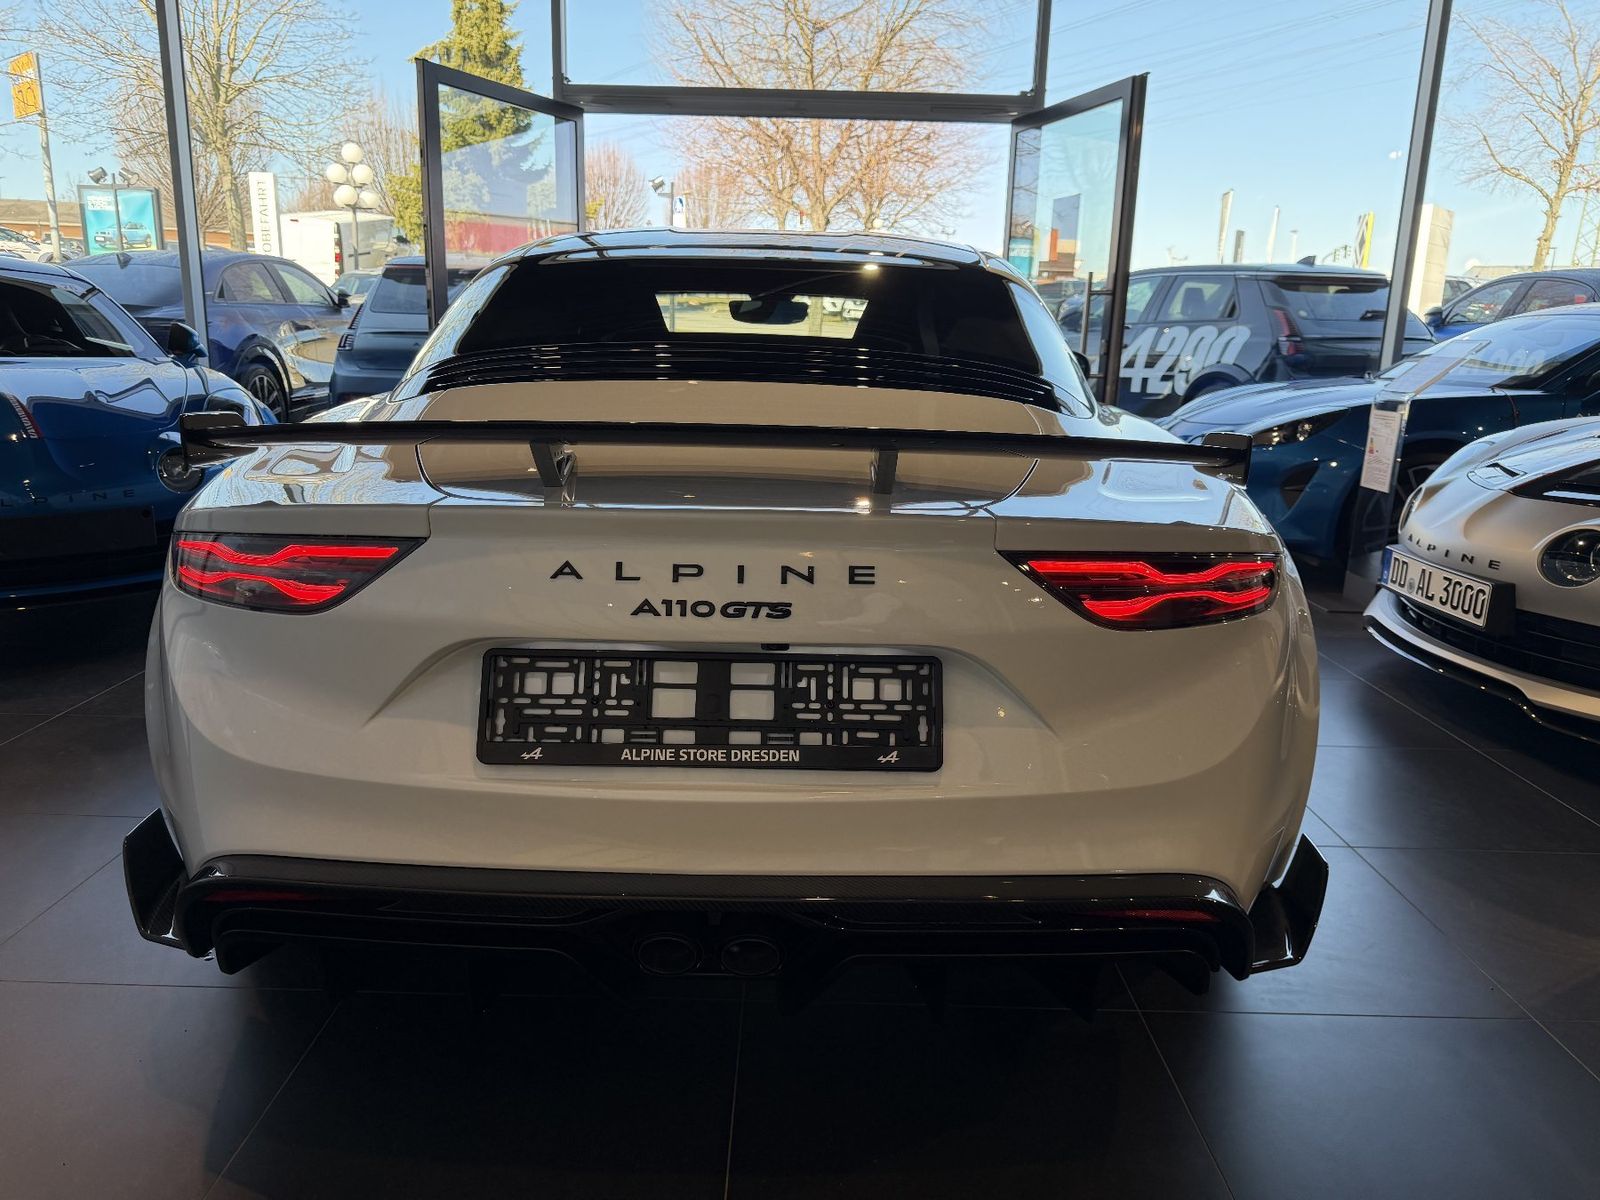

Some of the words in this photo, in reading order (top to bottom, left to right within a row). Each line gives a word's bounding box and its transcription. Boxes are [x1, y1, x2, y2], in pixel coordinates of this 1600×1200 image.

[1409, 534, 1501, 570] ALPINE
[550, 560, 875, 585] ALPINE
[1390, 557, 1409, 588] DD
[1417, 569, 1435, 601] AL
[1440, 577, 1486, 619] 3000
[620, 748, 676, 761] ALPINE
[679, 749, 727, 762] STORE
[731, 749, 800, 762] DRESDEN
